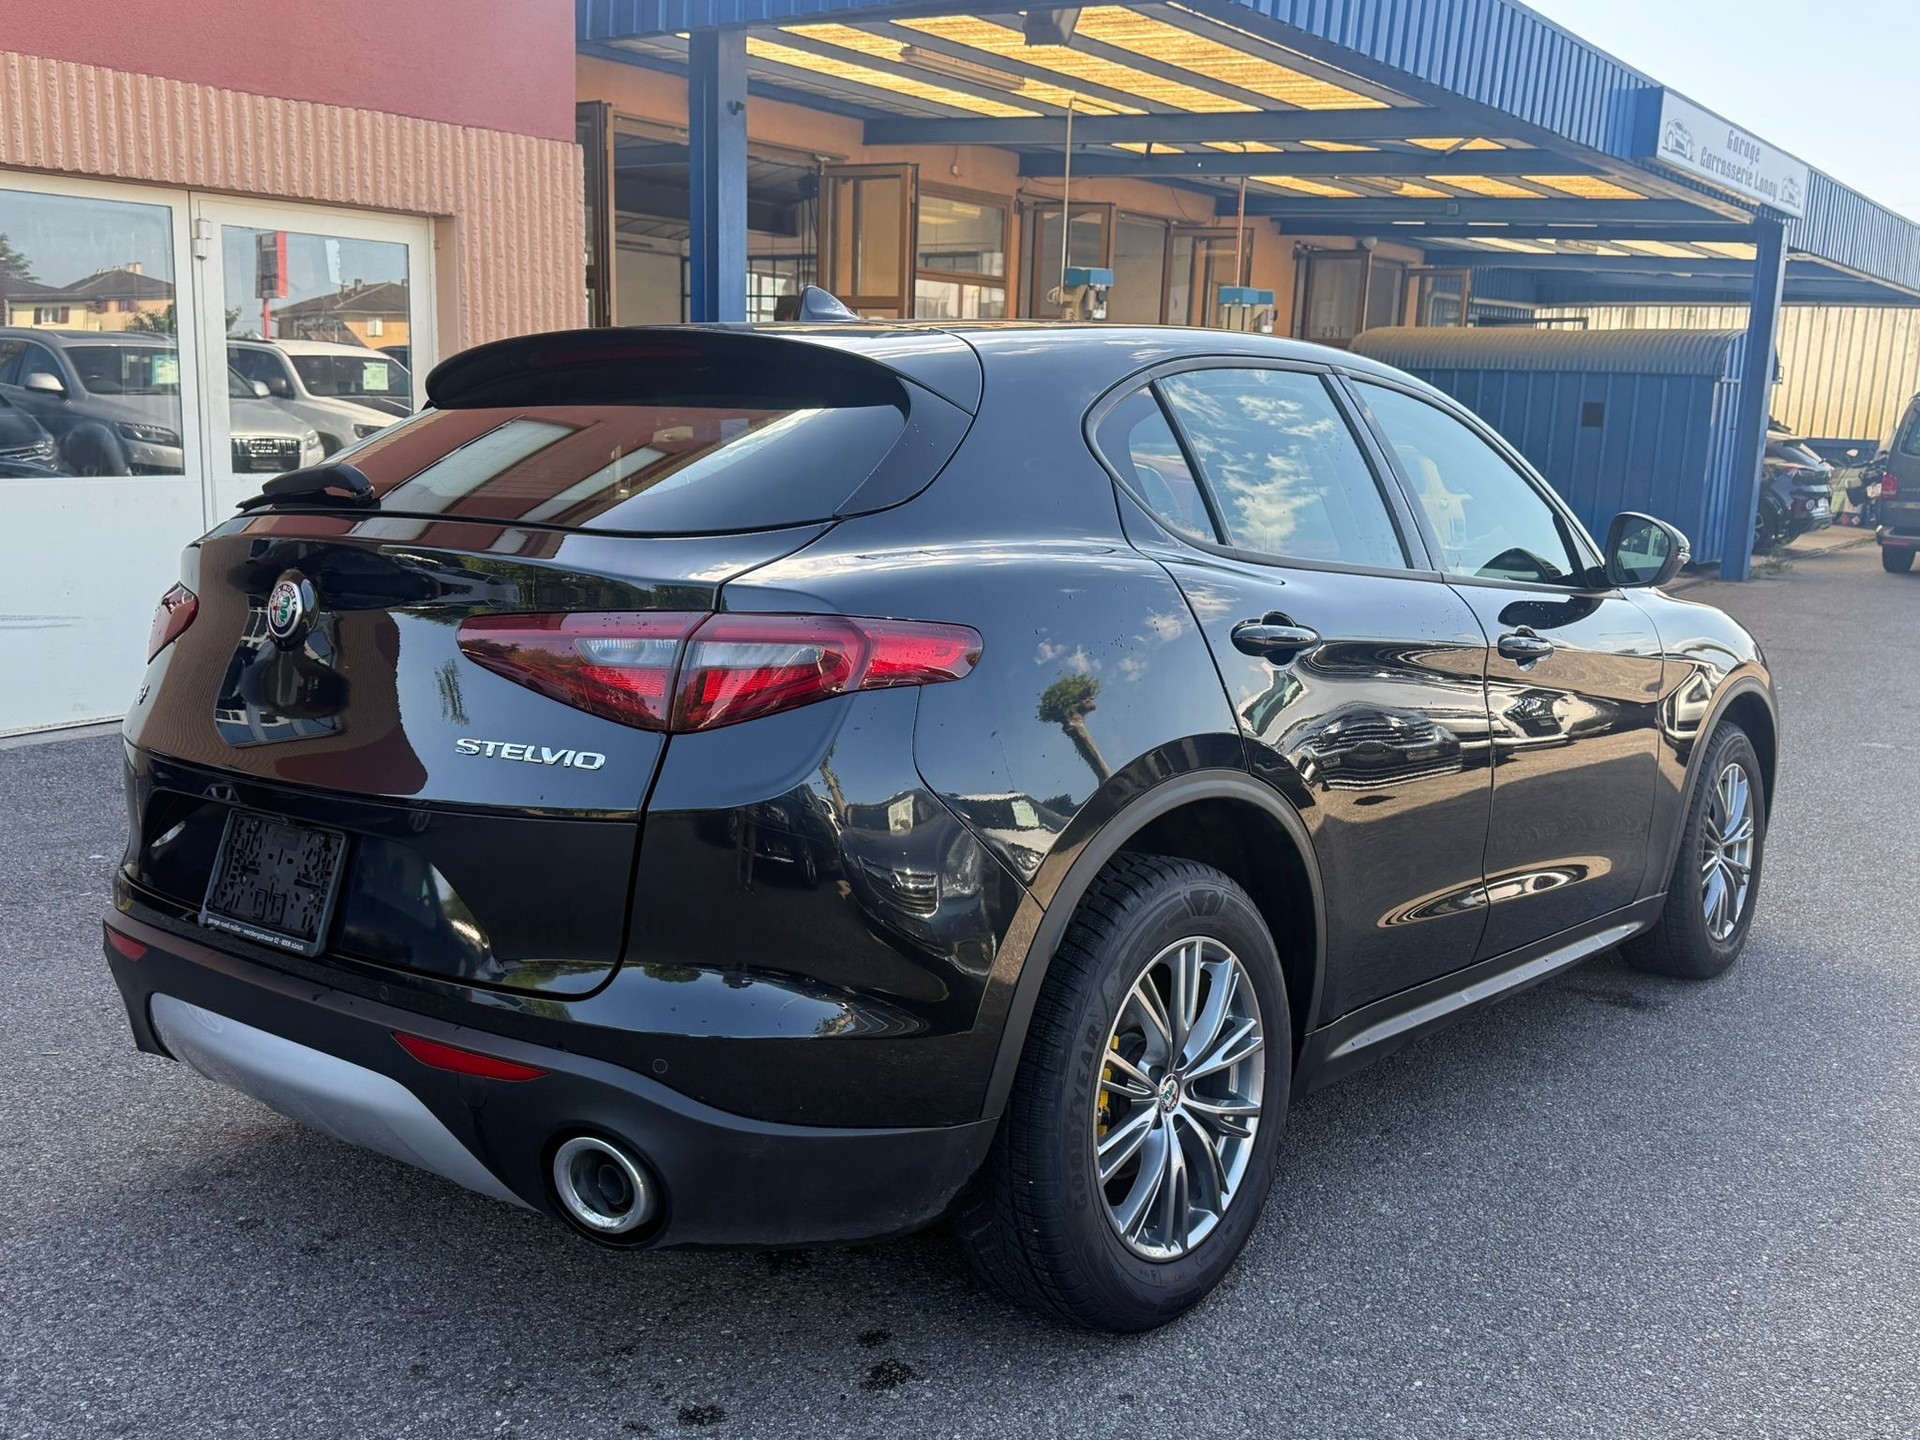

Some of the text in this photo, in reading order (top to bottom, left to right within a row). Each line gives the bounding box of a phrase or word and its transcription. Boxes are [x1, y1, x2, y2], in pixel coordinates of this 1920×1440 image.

[1726, 129, 1760, 166] Garage
[455, 738, 606, 770] STELVIO
[1069, 1023, 1100, 1212] GOODYEAR
